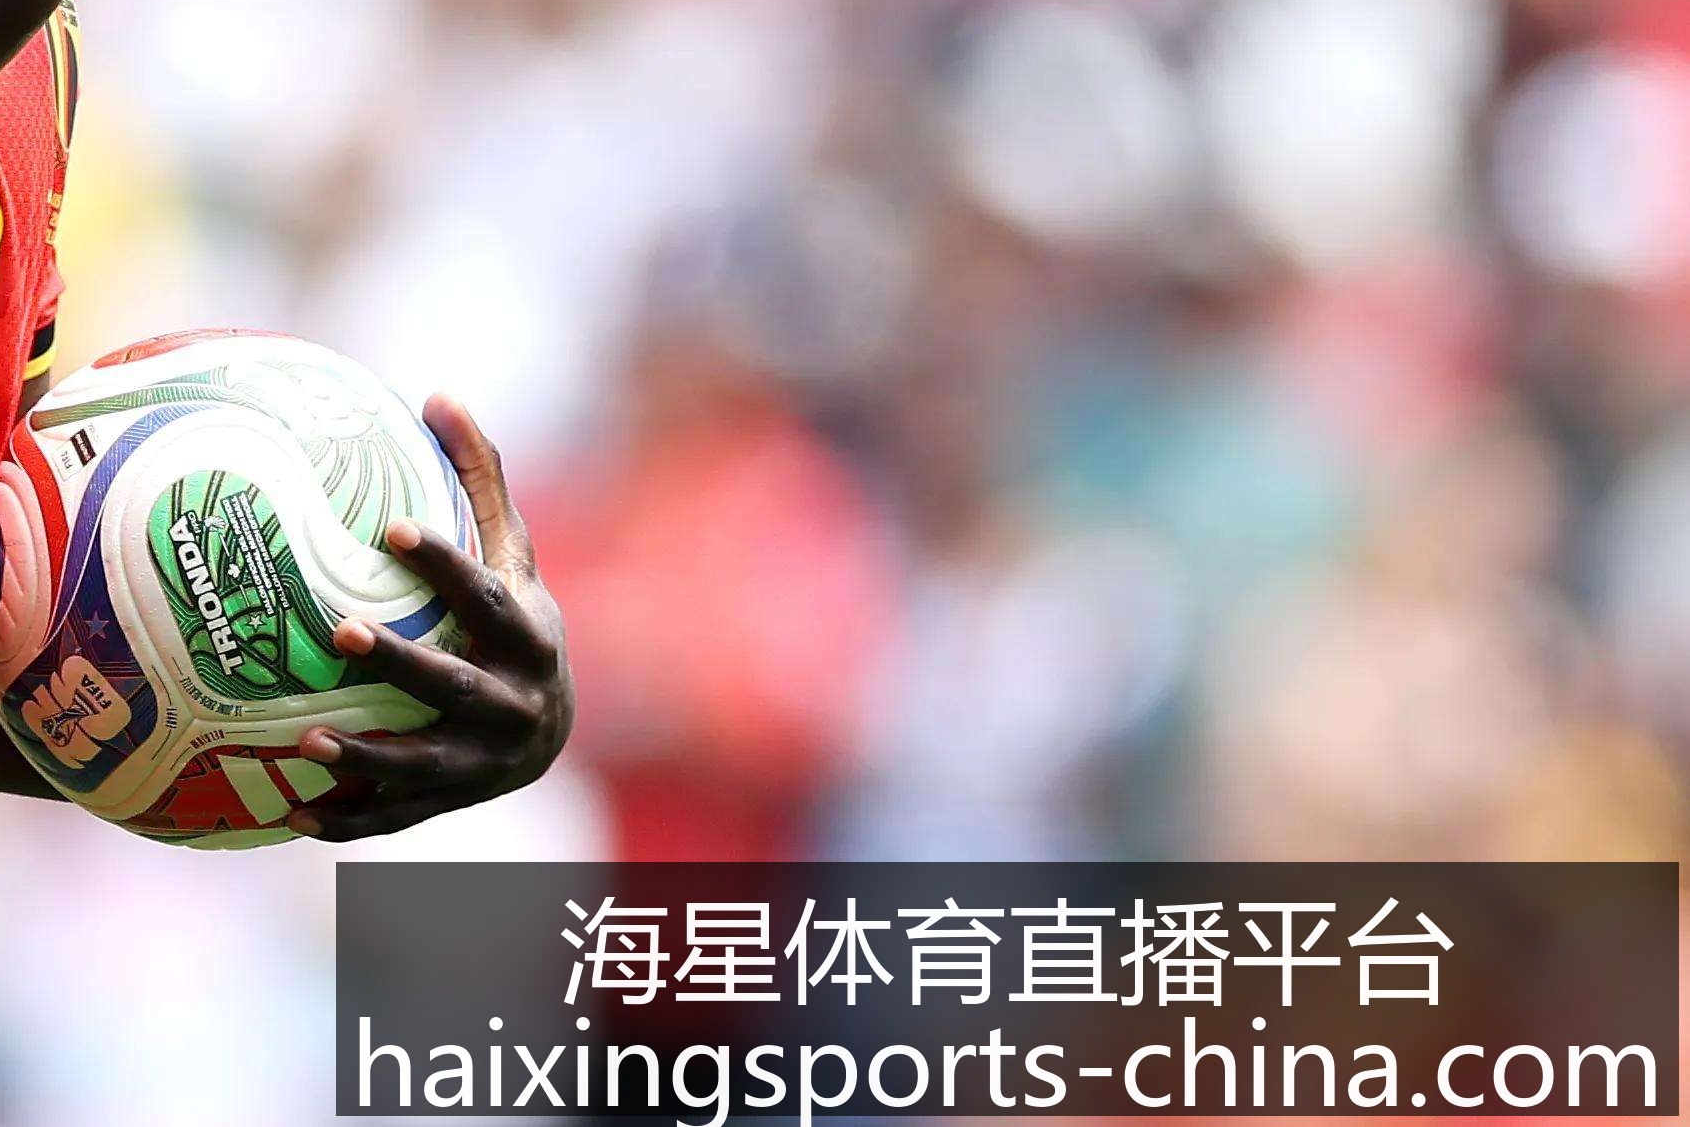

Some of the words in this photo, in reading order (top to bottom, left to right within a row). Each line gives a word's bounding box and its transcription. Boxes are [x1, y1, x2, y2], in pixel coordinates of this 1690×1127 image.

[188, 511, 202, 535] PRO
[169, 515, 242, 674] TRIONDA
[81, 674, 111, 709] FIFA
